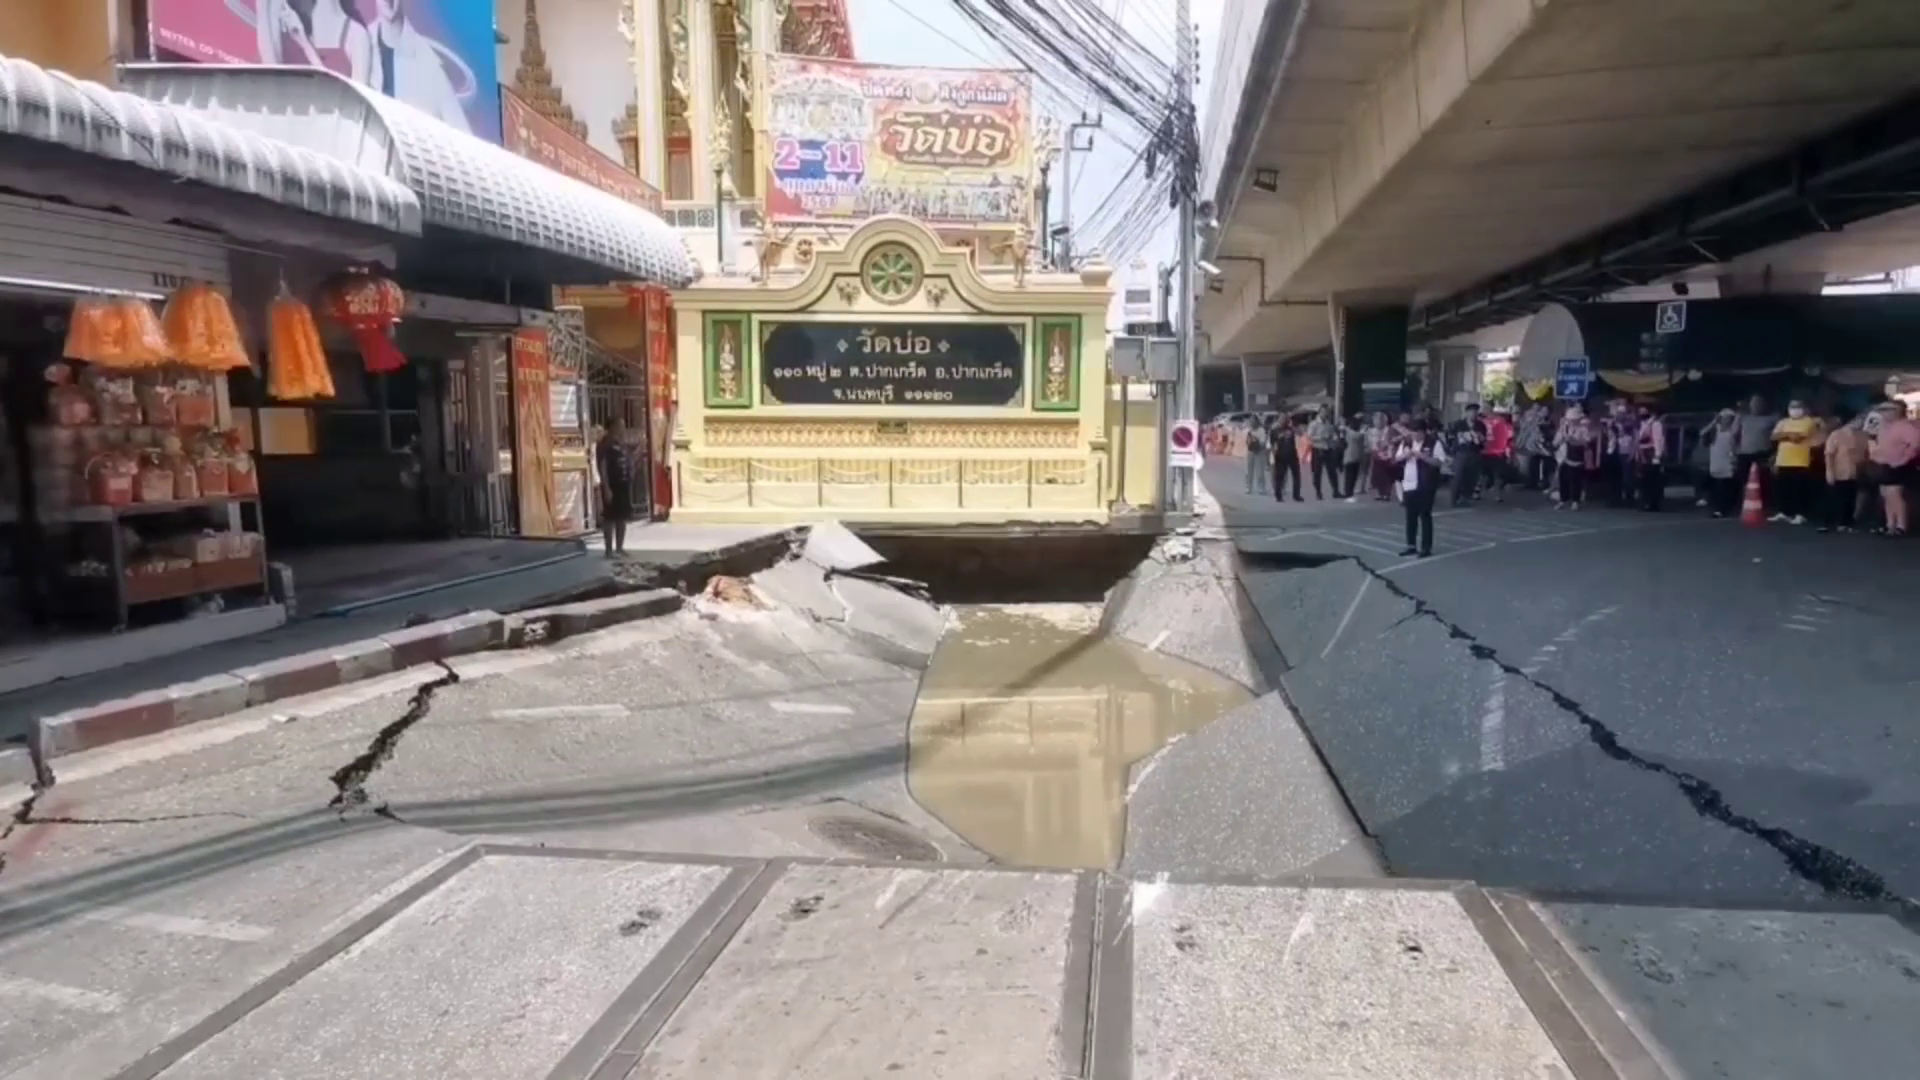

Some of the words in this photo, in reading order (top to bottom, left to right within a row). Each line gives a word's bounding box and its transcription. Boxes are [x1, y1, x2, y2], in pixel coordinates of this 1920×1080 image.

[889, 111, 1005, 156] วัดบ่อ
[774, 137, 864, 173] 2-11
[856, 328, 931, 354] วัดบ่อ
[805, 360, 827, 383] หมู่
[832, 384, 894, 404] จ.นนทบุรี
